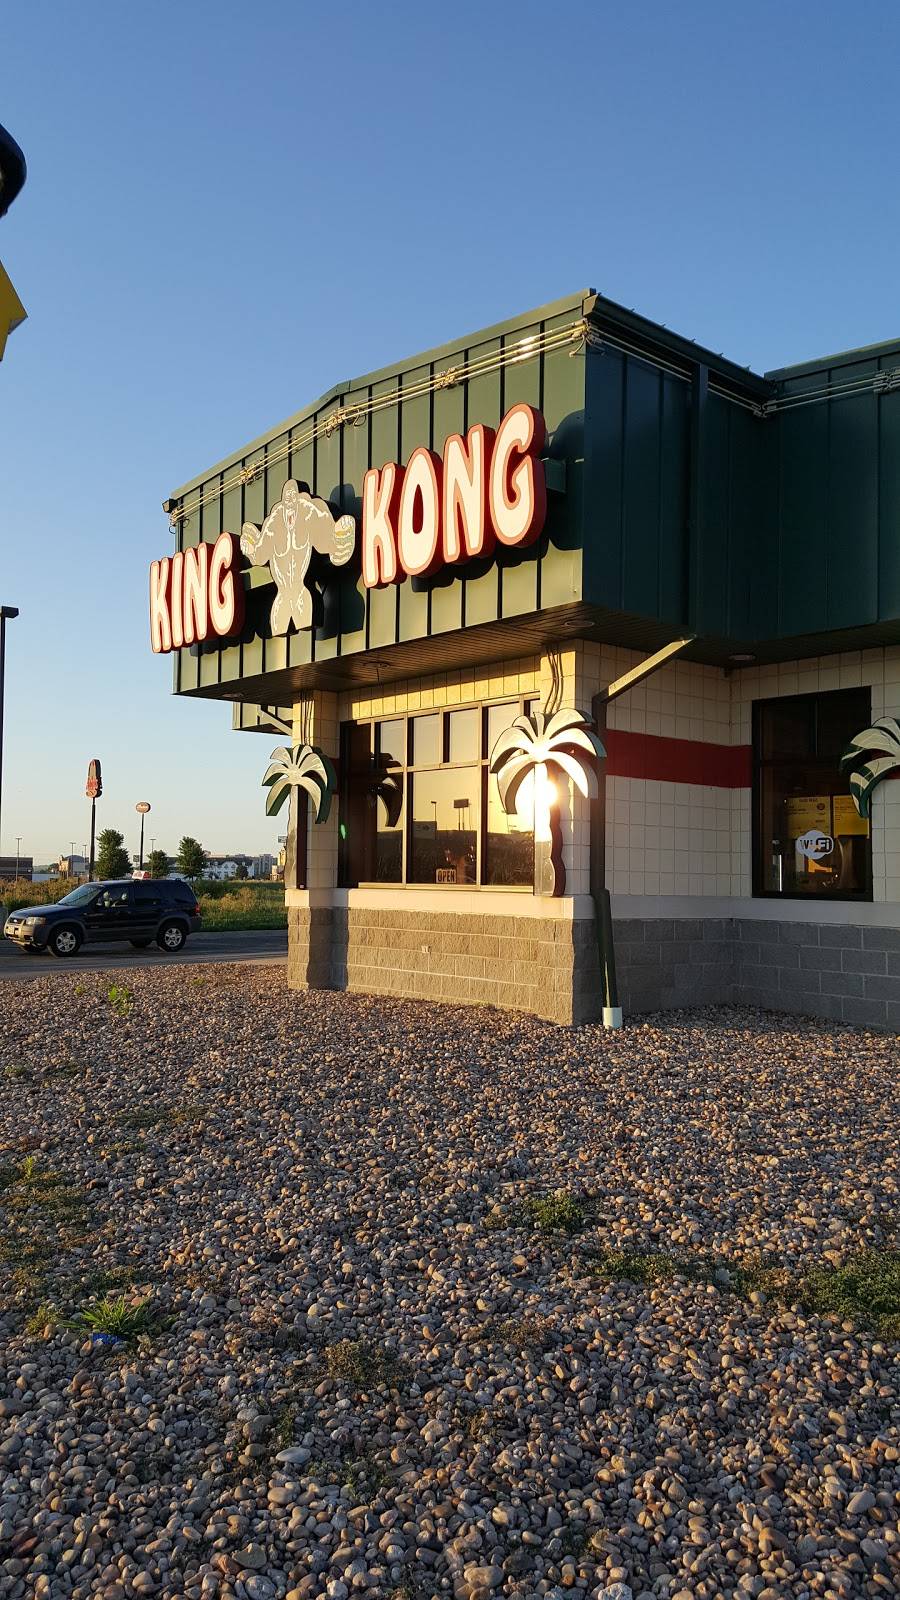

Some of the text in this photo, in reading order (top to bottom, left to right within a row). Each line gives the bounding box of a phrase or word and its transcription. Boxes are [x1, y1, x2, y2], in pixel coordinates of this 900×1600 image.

[150, 403, 545, 653] KING KONG
[437, 870, 455, 882] OPEN
